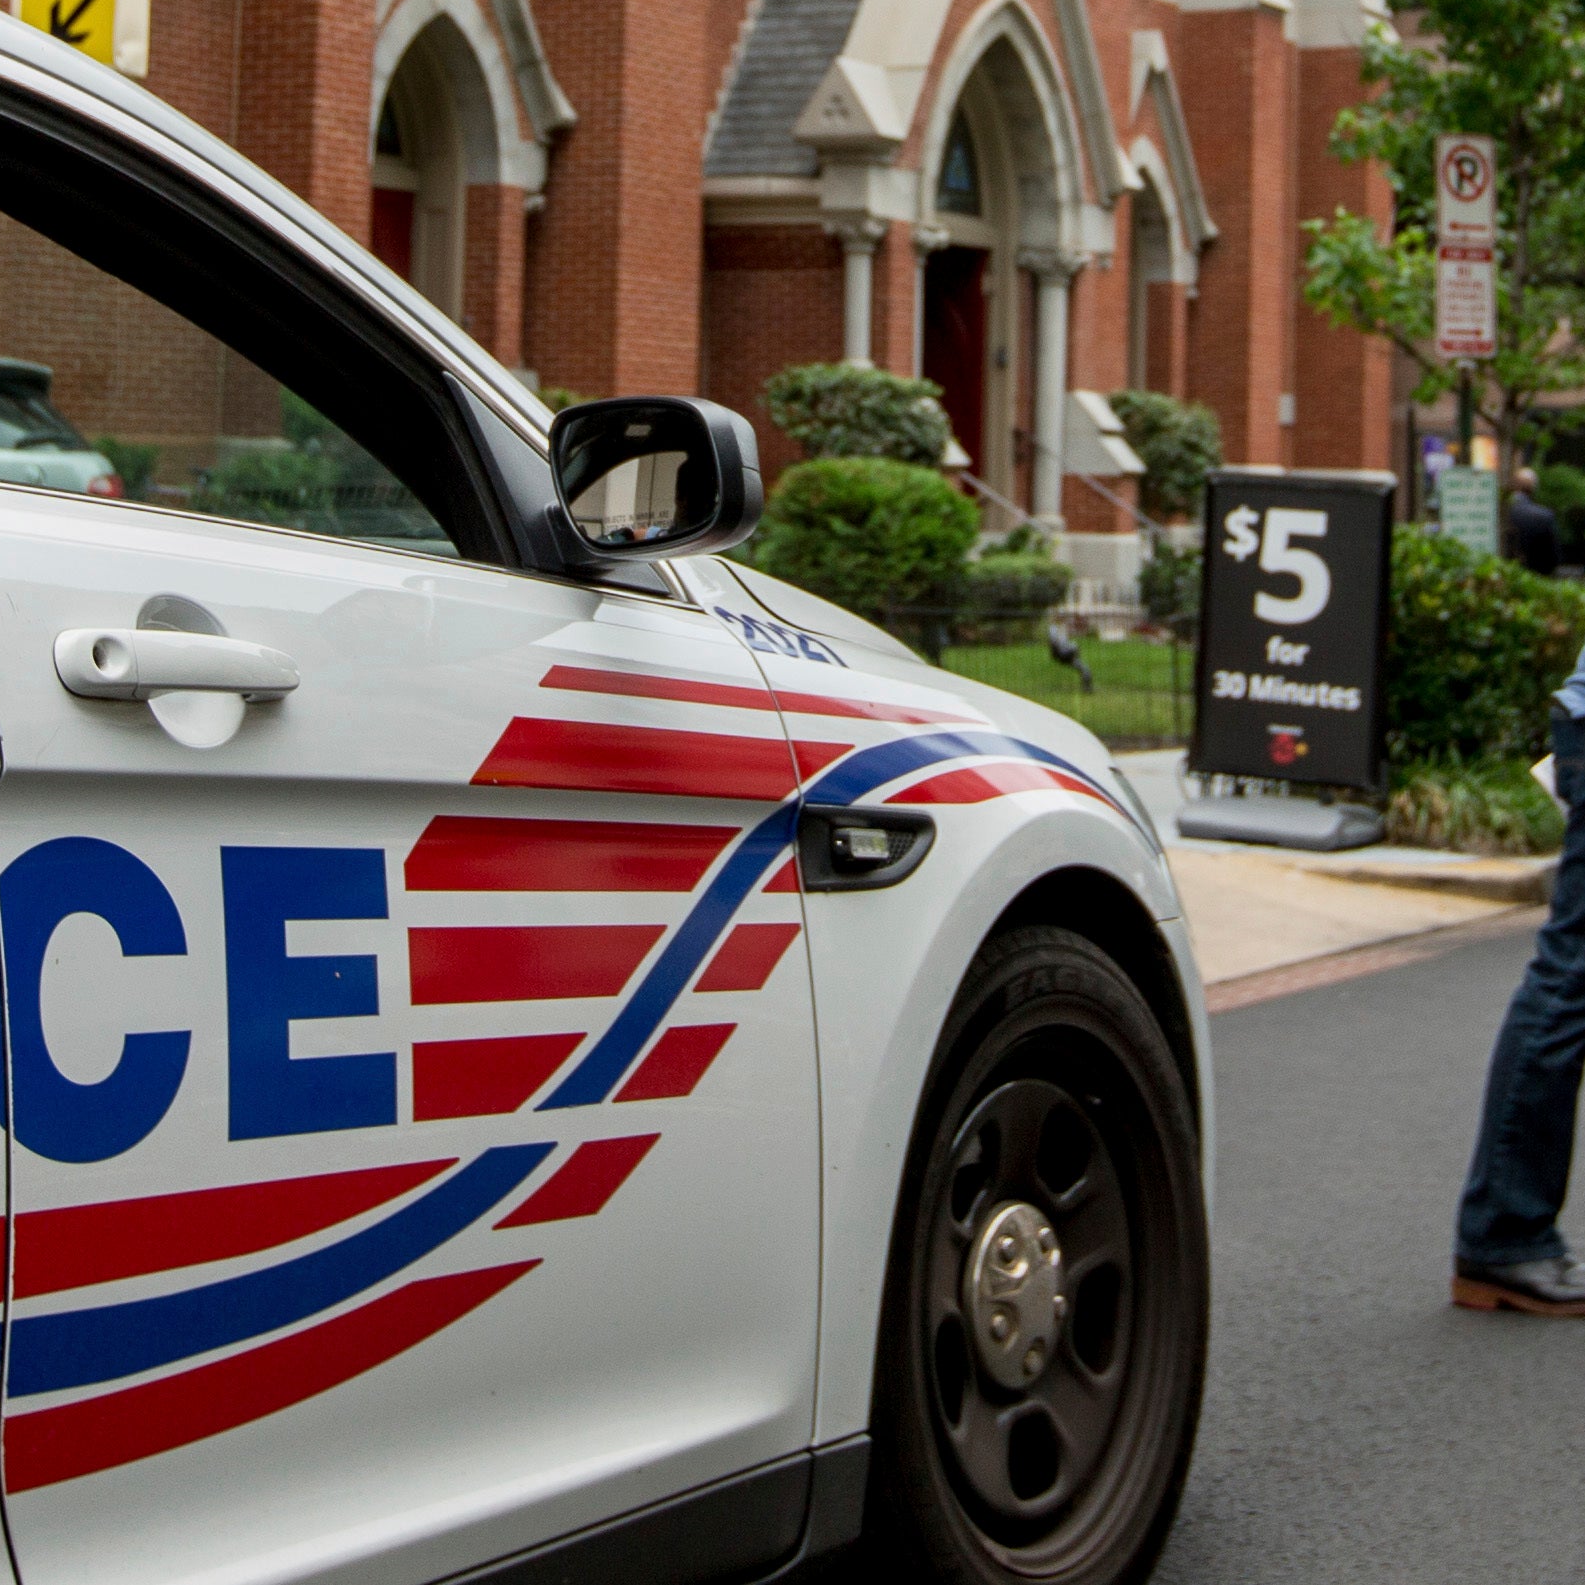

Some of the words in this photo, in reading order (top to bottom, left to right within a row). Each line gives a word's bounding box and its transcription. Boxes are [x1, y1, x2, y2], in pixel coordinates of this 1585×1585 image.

[1222, 505, 1331, 624] $5
[1267, 636, 1310, 665] for
[1212, 671, 1246, 698] 30
[1249, 675, 1361, 710] Minutes
